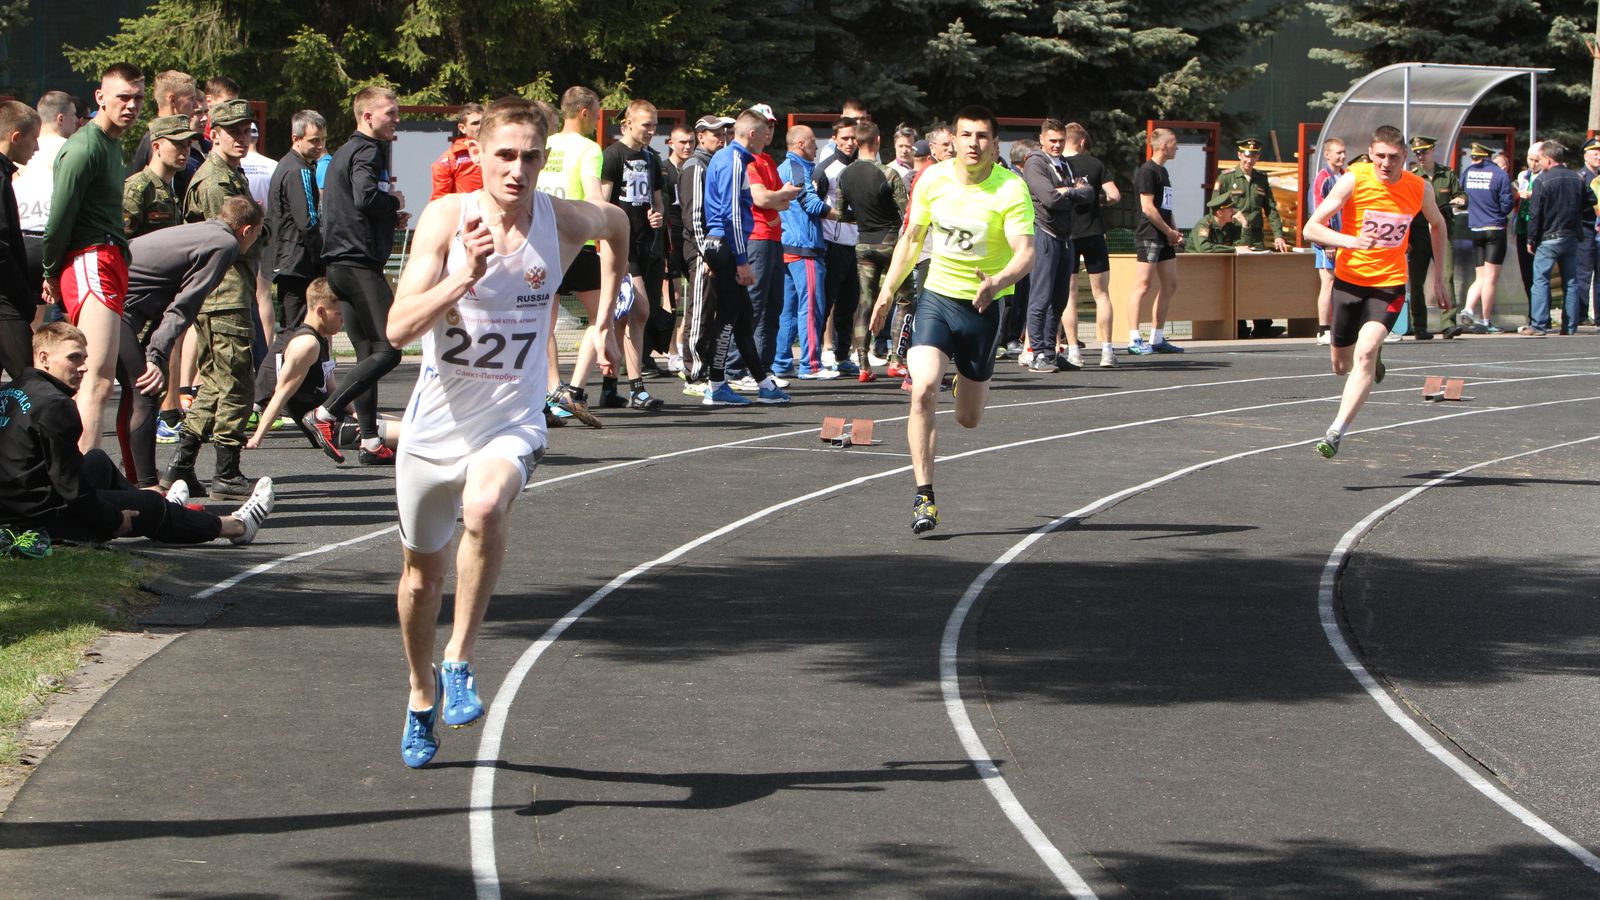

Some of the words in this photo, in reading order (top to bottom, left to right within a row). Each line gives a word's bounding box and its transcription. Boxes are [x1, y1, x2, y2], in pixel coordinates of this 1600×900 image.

[629, 180, 649, 197] 10
[939, 225, 974, 252] 78
[1364, 220, 1408, 242] 223
[516, 293, 550, 303] RUSSIA
[441, 327, 538, 370] 227
